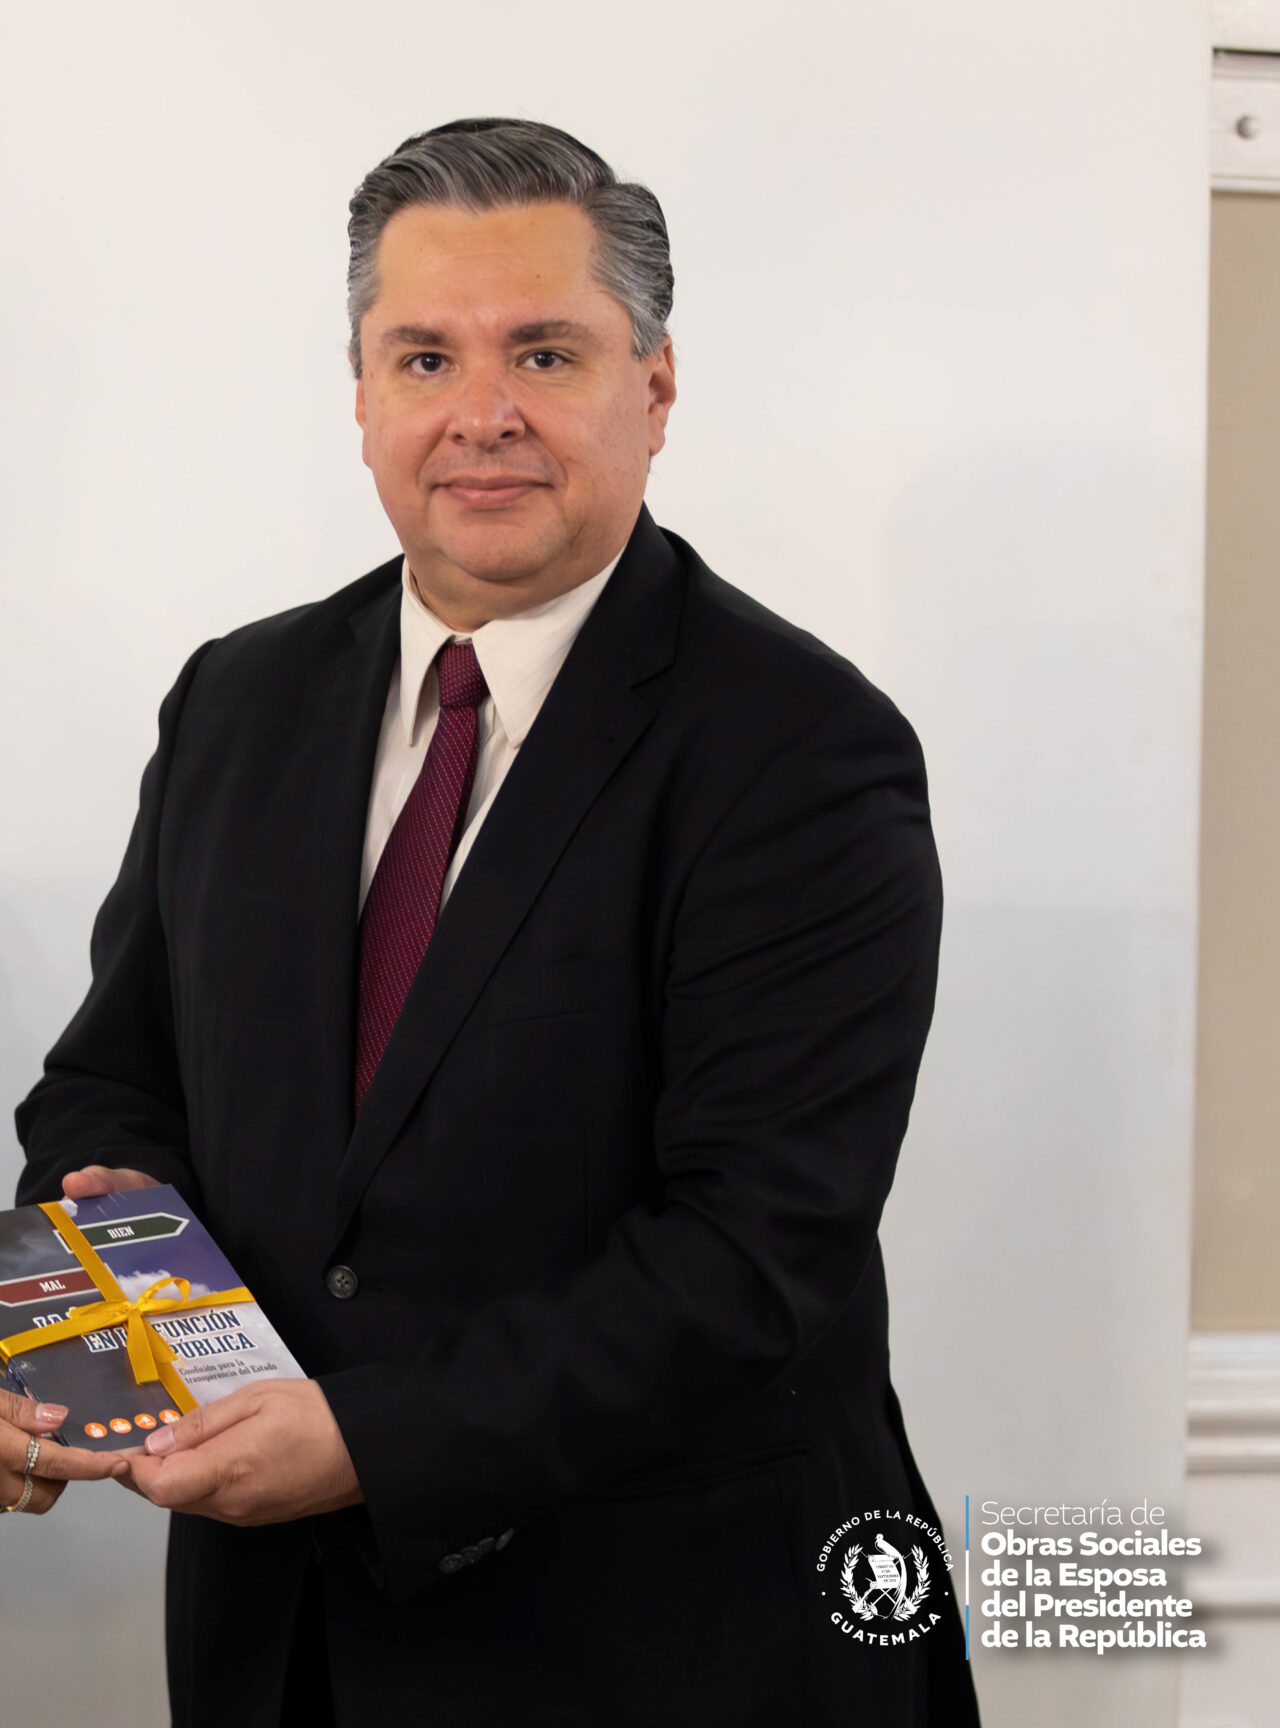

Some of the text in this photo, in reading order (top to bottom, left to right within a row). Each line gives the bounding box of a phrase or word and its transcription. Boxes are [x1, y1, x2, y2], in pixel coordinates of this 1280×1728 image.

[107, 1226, 134, 1239] BIEN
[39, 1280, 66, 1292] MAL
[82, 1330, 119, 1352] EN
[218, 1362, 235, 1371] para
[236, 1358, 245, 1367] la
[185, 1362, 278, 1384] transparencia del Estado
